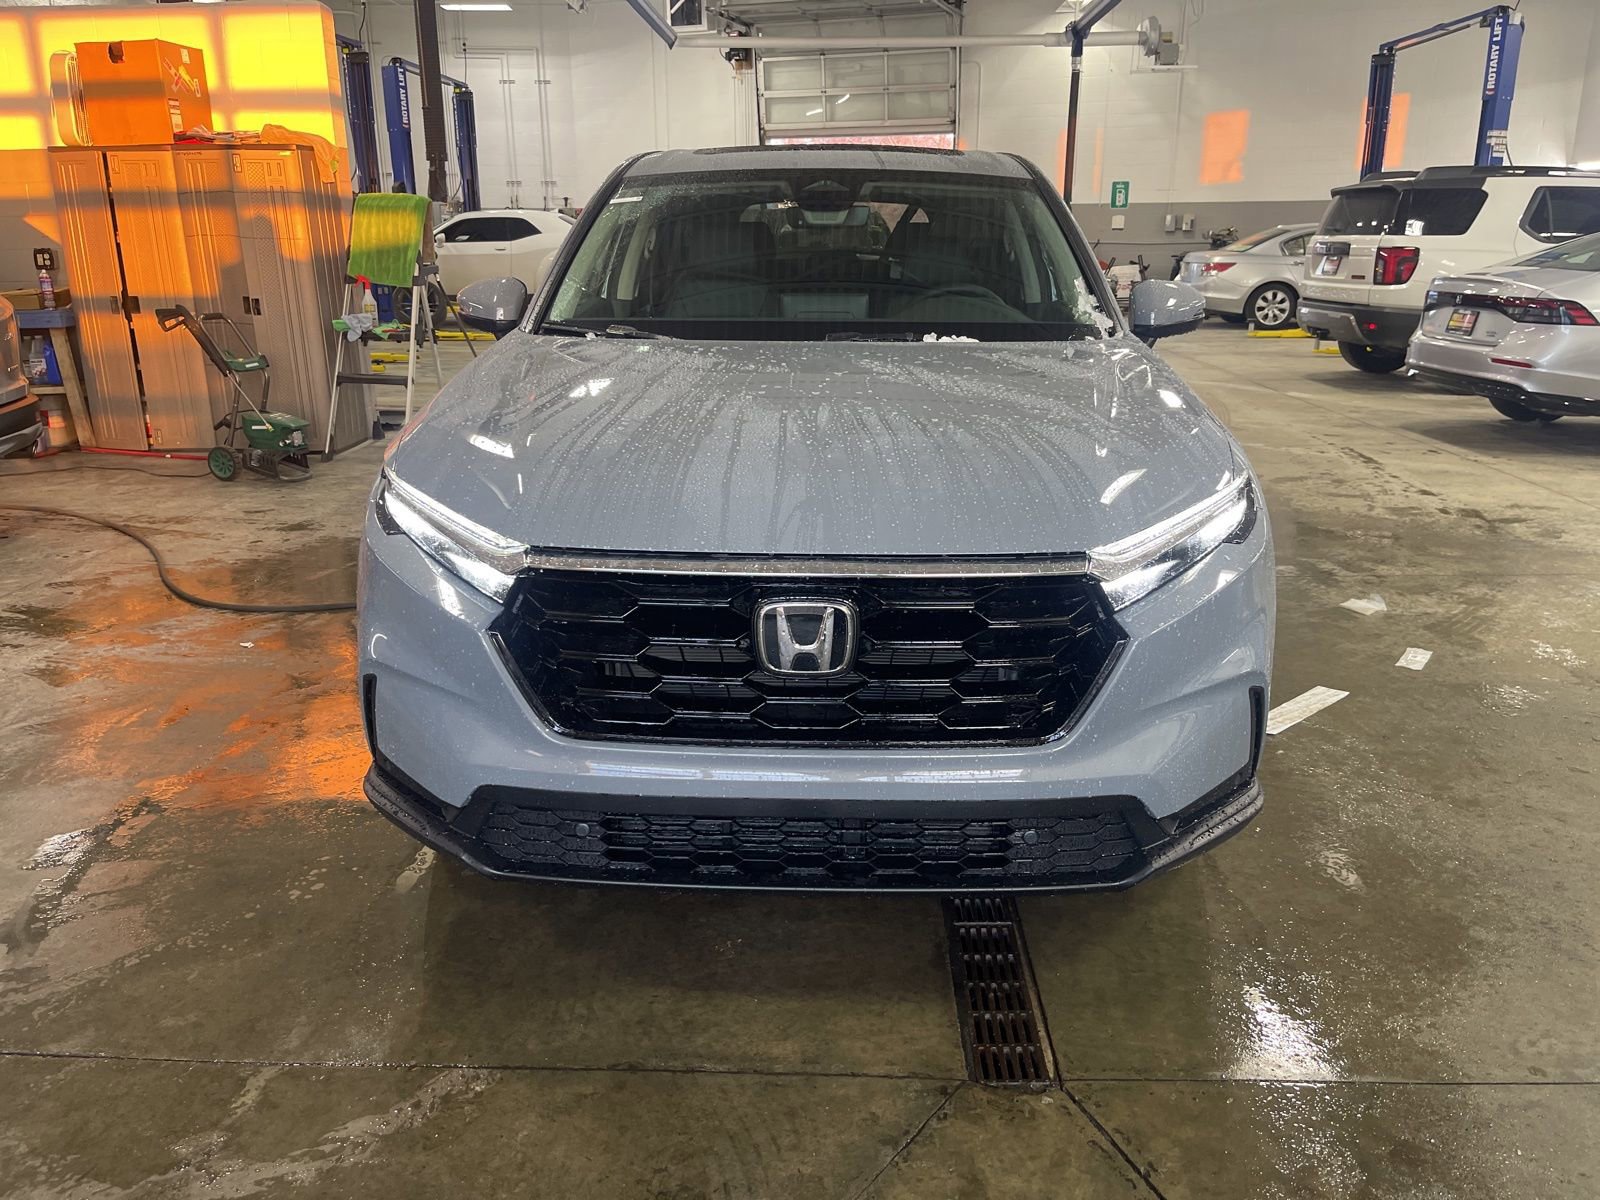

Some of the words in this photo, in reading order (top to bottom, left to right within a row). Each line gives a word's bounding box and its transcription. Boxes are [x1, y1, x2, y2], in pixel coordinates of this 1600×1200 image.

[1493, 17, 1503, 42] LIFT
[398, 68, 406, 86] LIFT
[1487, 45, 1500, 89] ROTARY
[399, 88, 409, 123] ROTARY
